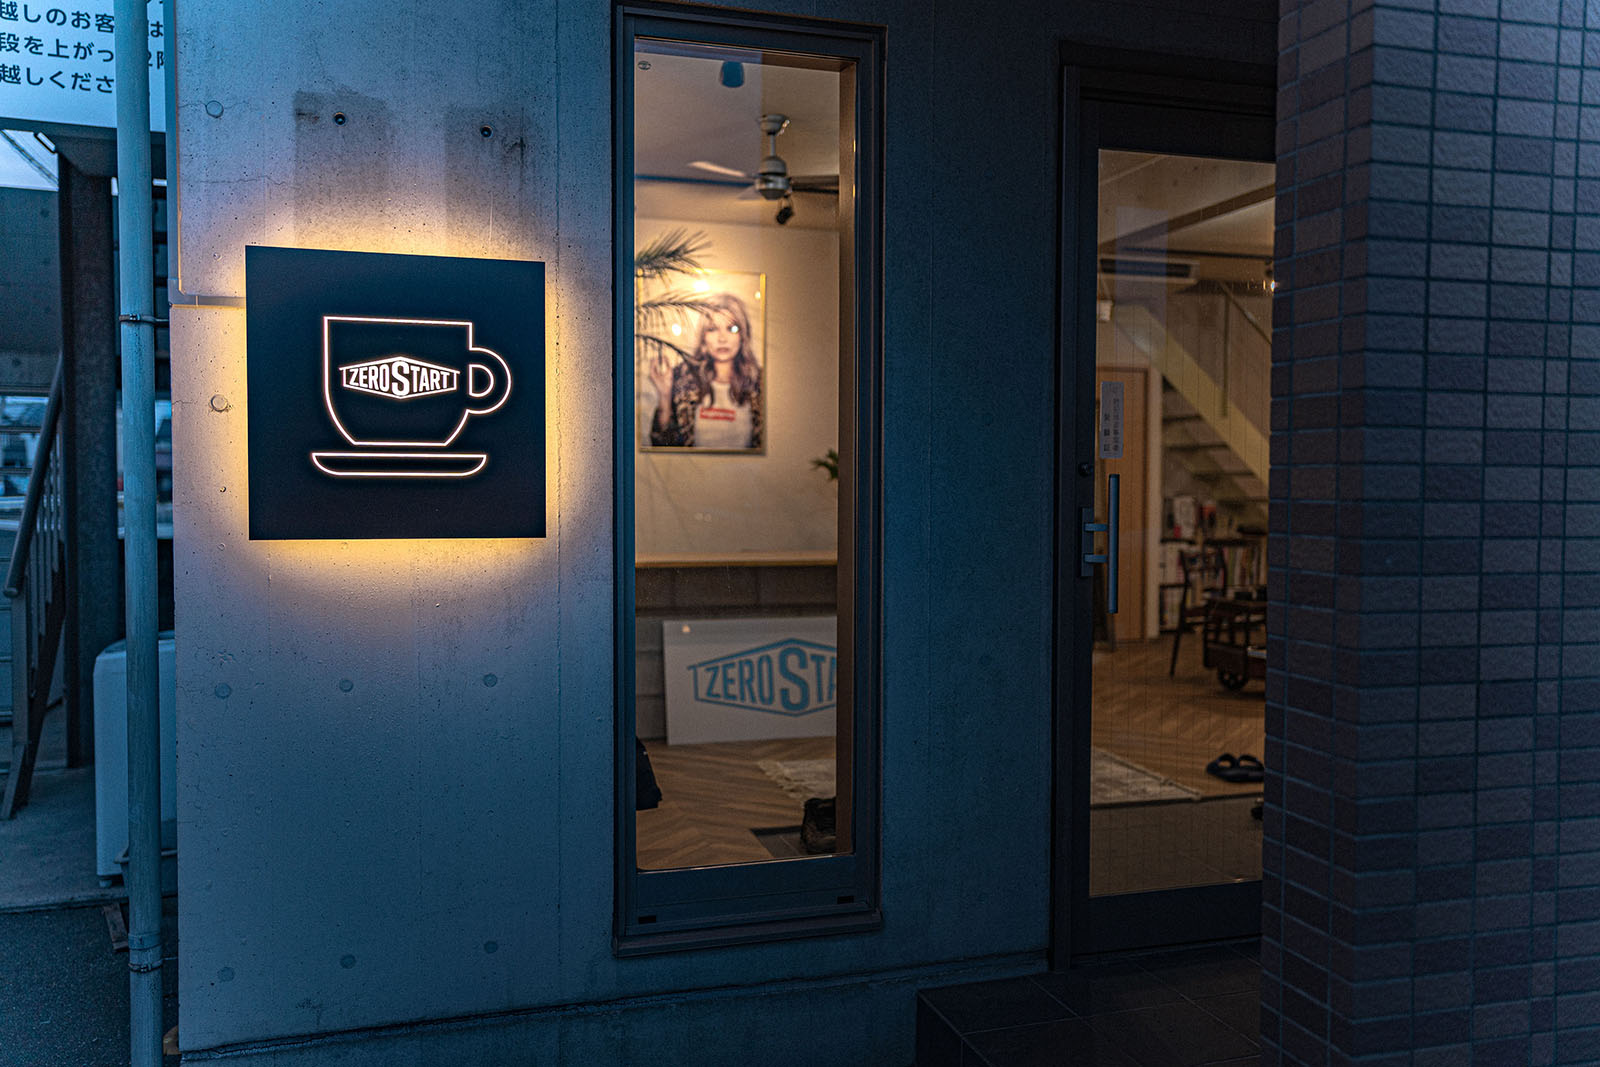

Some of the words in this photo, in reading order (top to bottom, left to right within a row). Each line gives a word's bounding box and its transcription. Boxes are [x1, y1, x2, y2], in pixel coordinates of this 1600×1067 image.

[0, 1, 164, 38] 越しのお客は
[0, 32, 164, 69] 段を上がっ2
